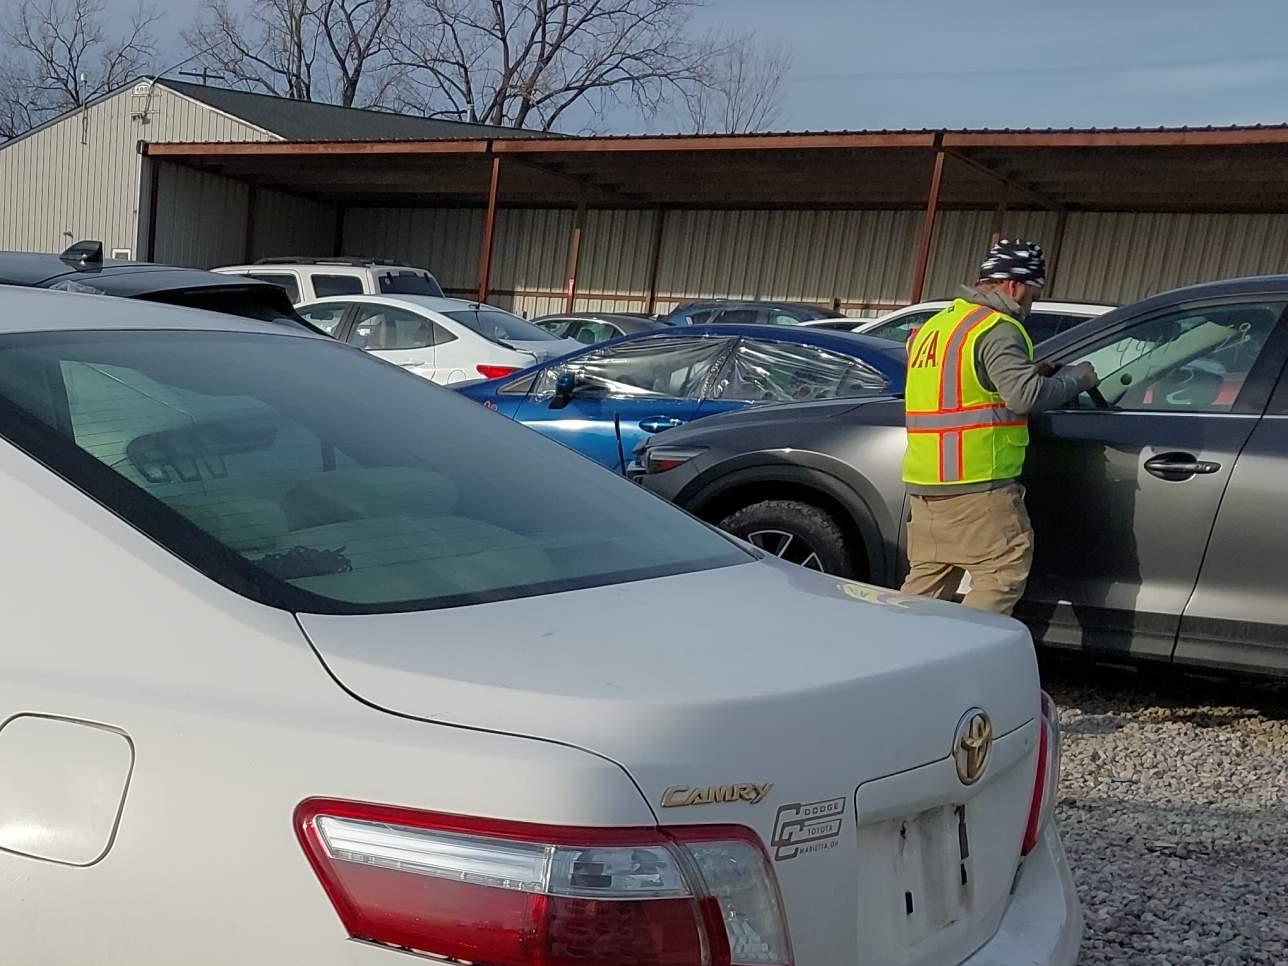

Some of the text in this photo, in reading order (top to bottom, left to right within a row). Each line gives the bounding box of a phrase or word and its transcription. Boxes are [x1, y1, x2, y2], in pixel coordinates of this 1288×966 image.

[661, 783, 774, 807] CAMRY
[804, 803, 839, 816] DODGE
[808, 824, 833, 836] TOYOTA
